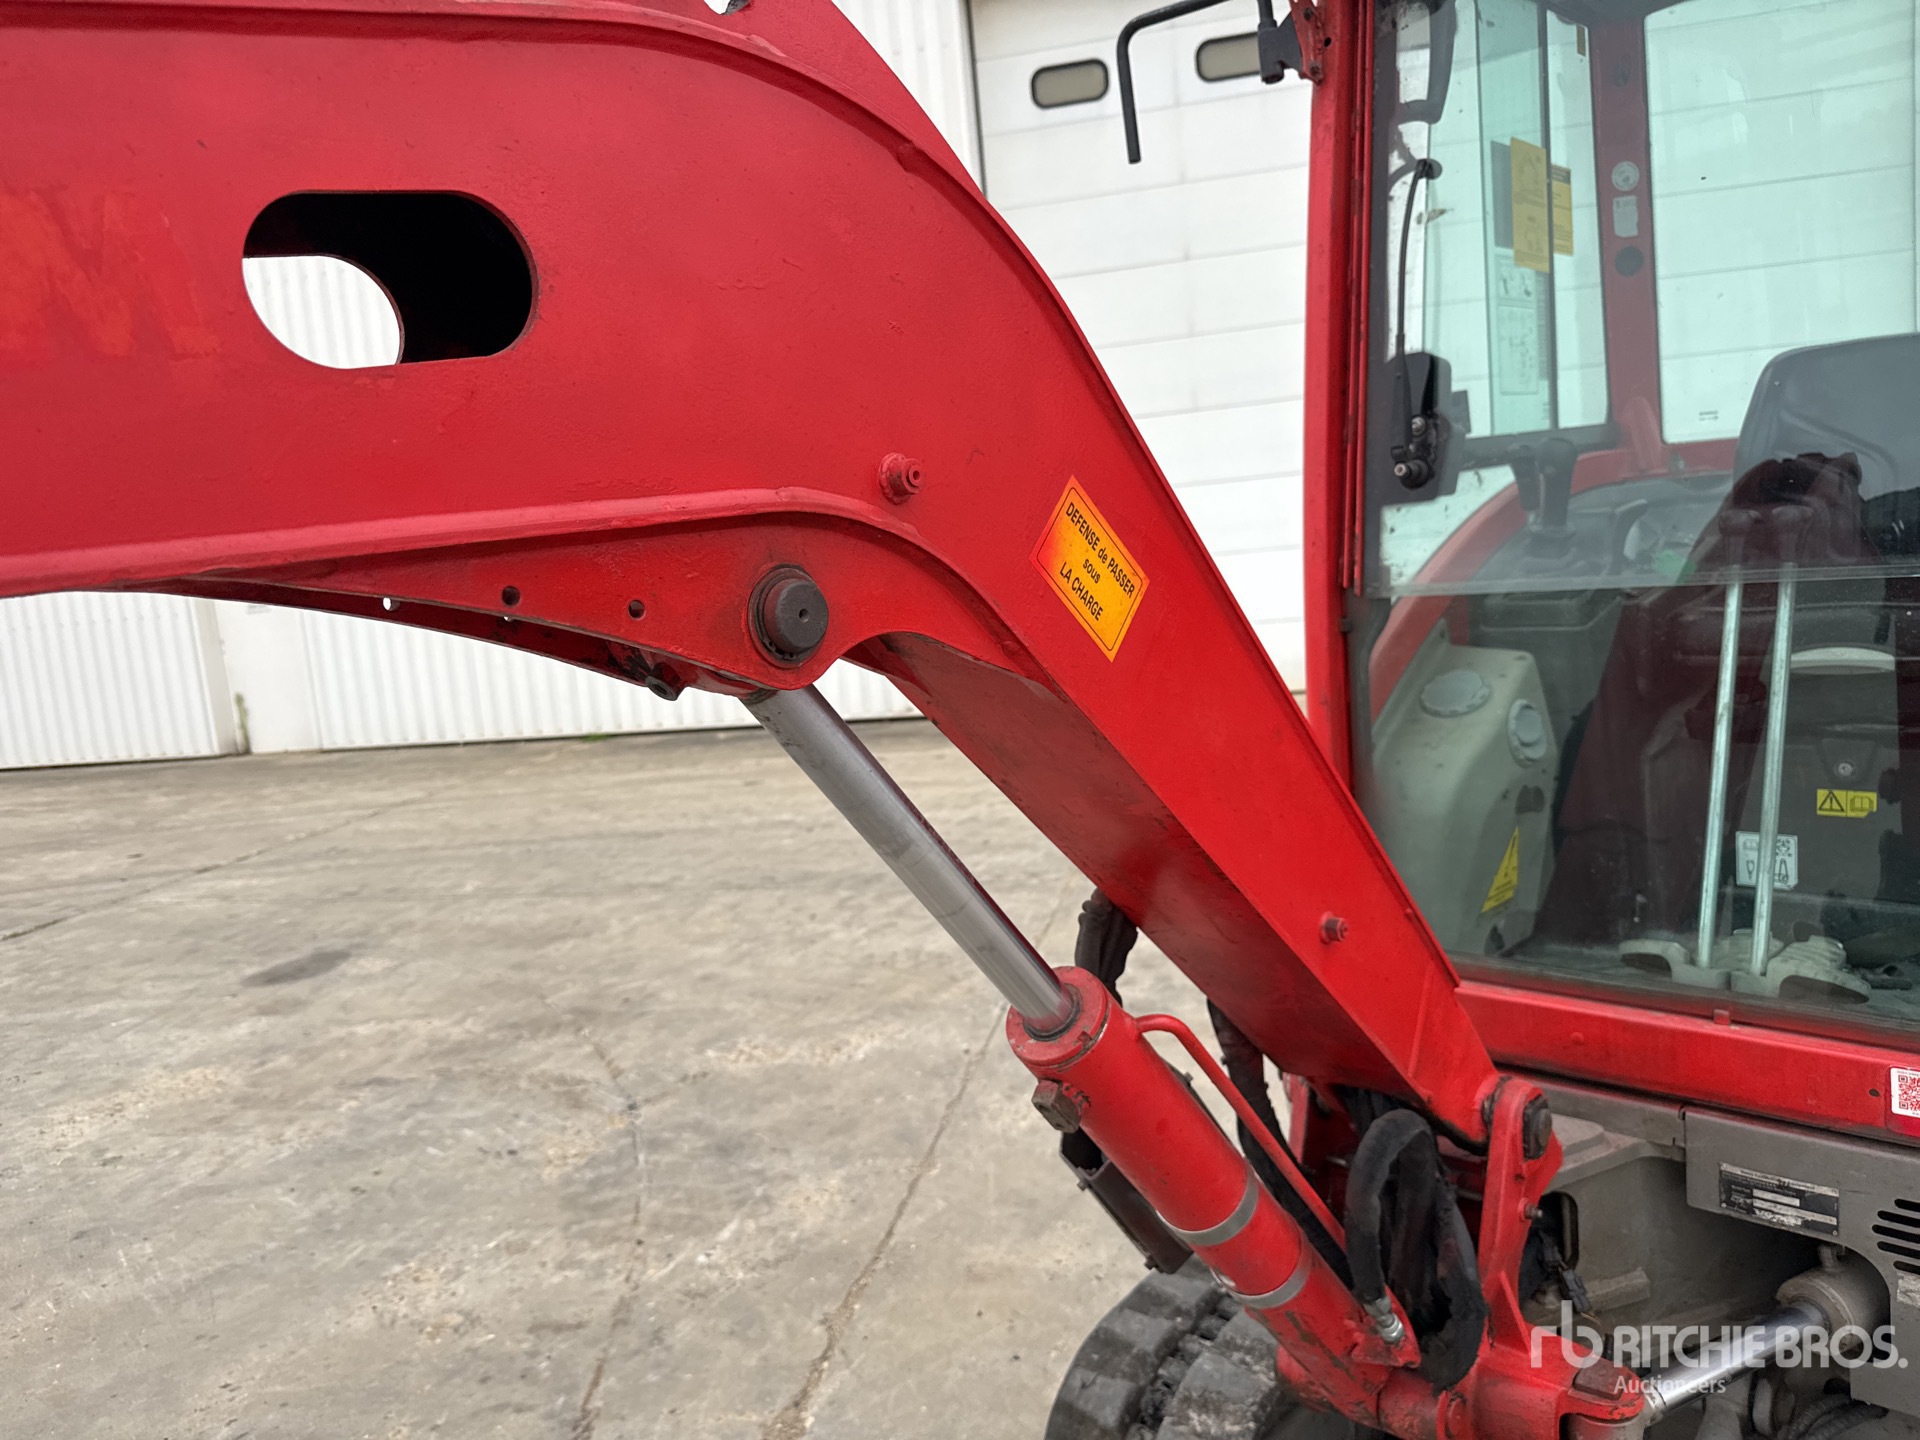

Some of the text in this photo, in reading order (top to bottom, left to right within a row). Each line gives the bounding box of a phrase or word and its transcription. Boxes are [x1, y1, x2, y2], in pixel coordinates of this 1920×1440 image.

[1066, 502, 1135, 598] DEFENSE de PASSER
[1083, 559, 1101, 584] sous
[1060, 562, 1104, 621] LA CHARGE
